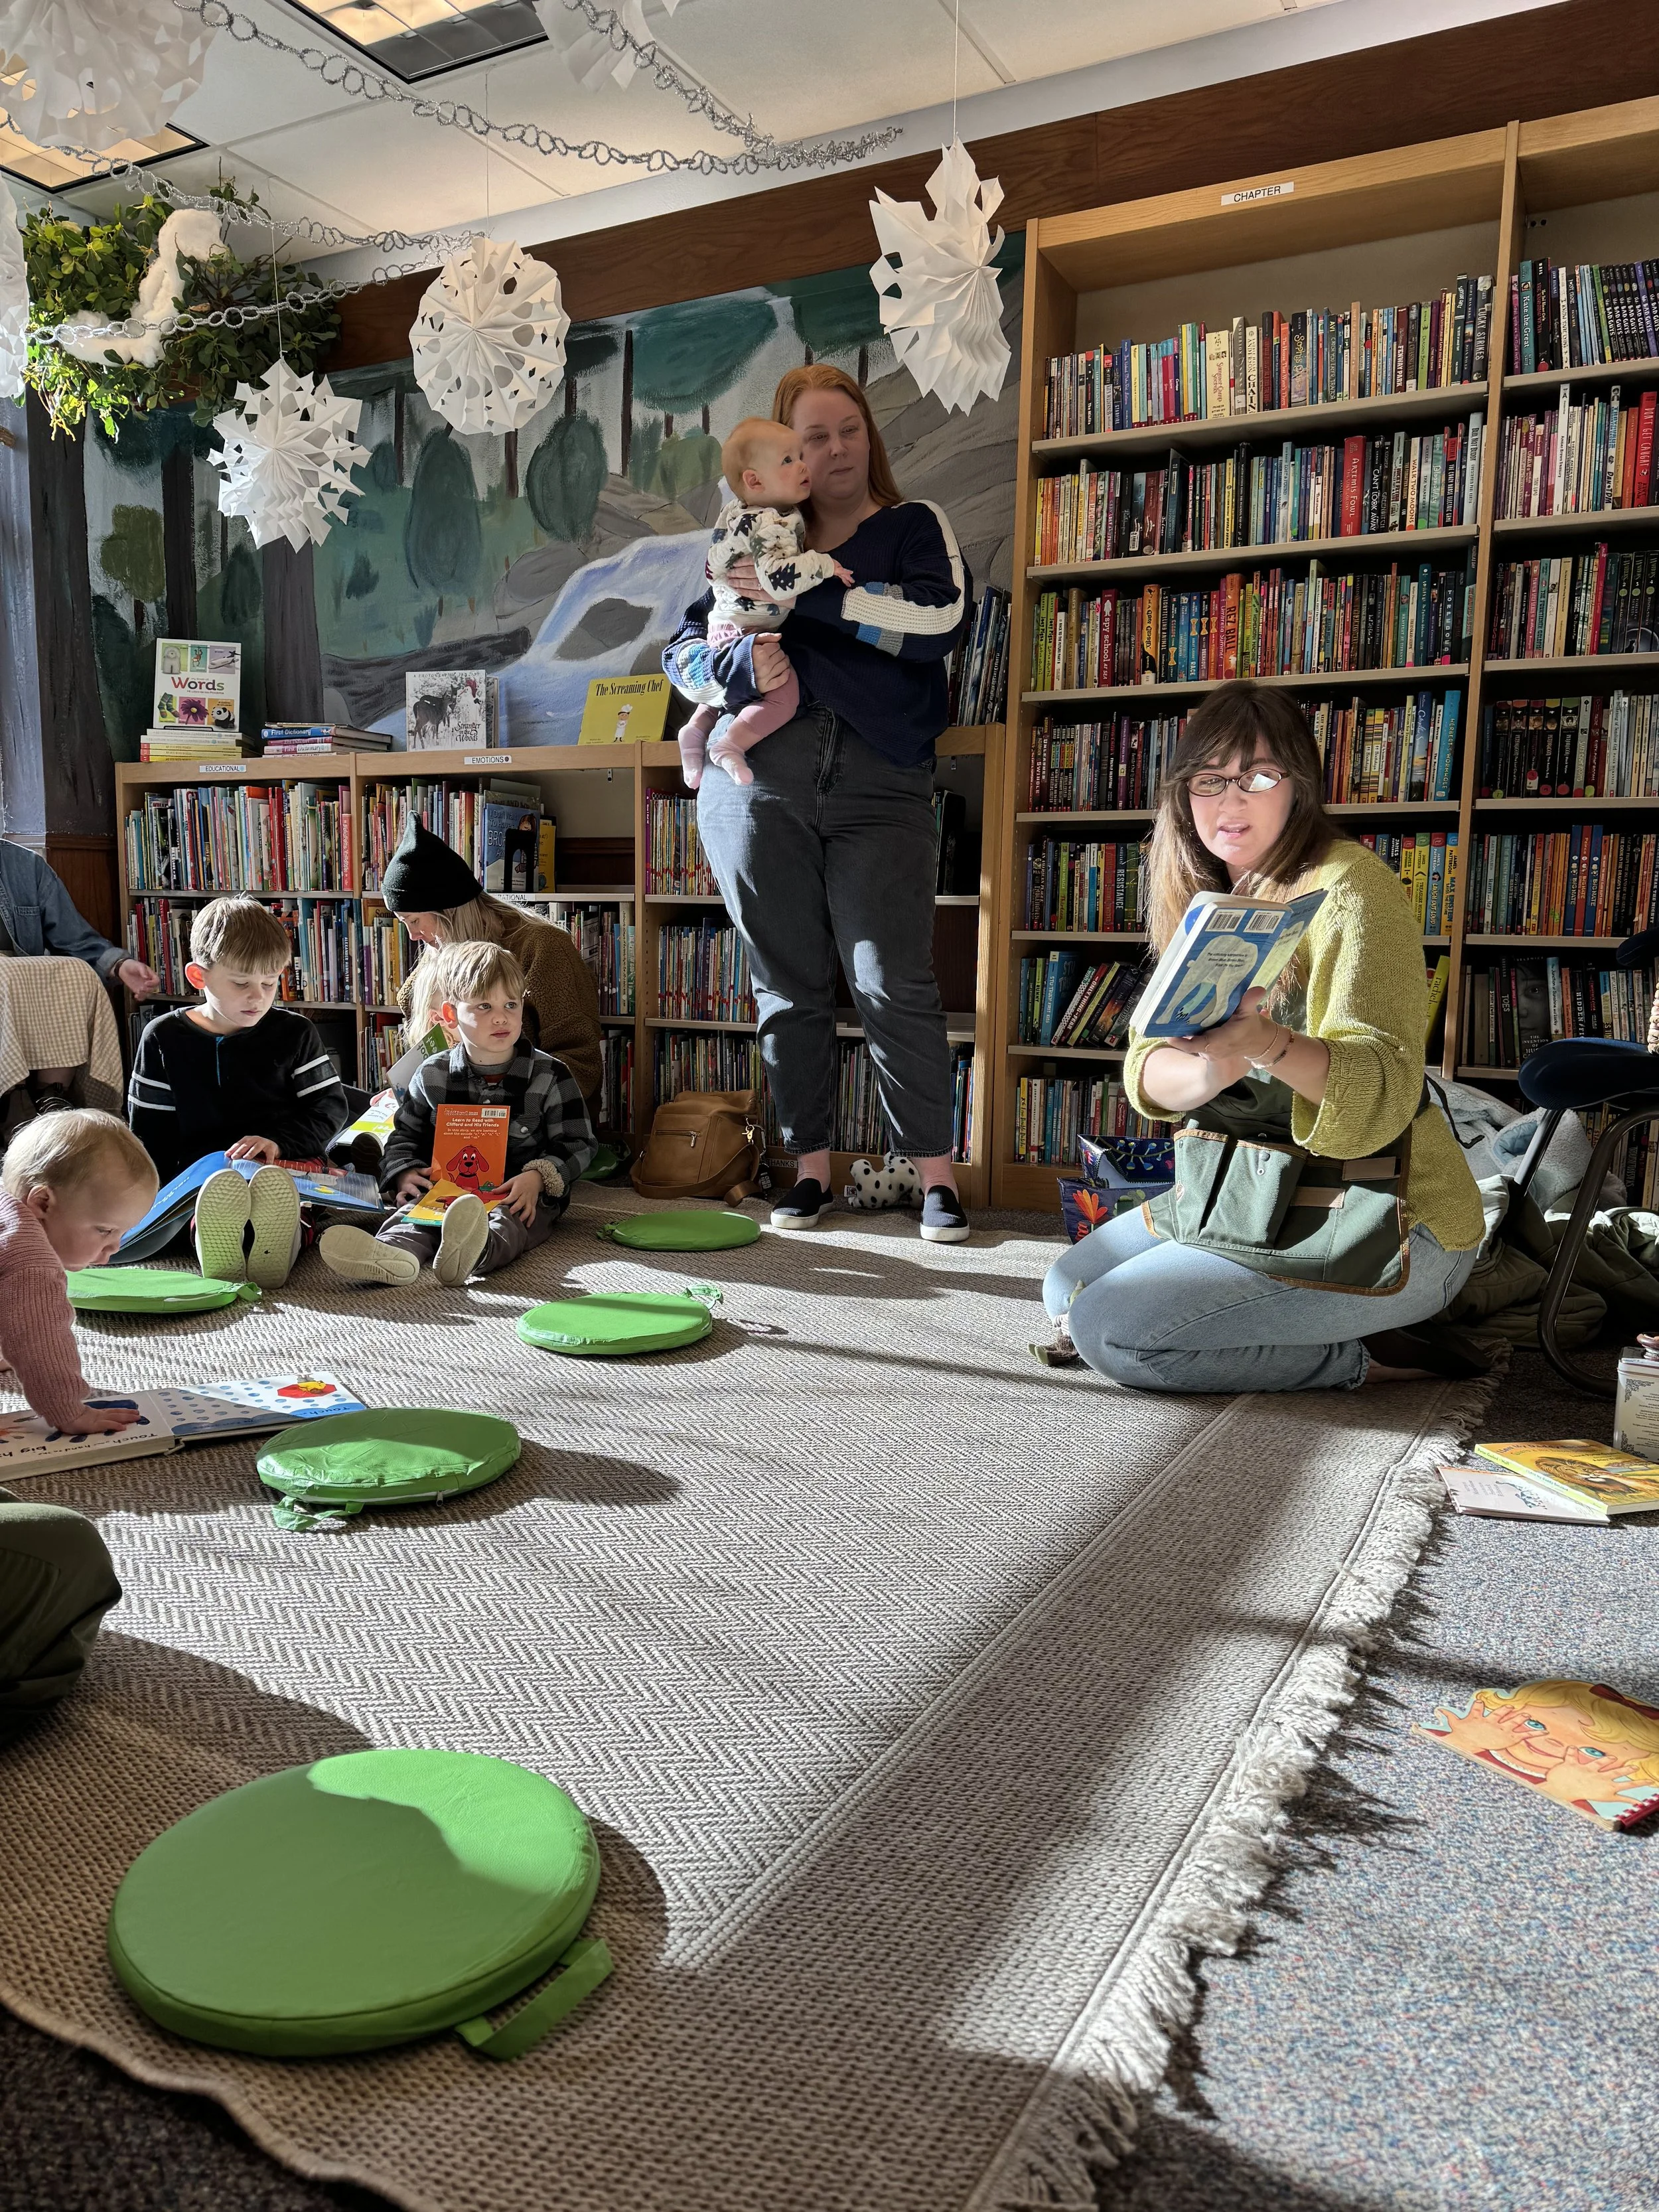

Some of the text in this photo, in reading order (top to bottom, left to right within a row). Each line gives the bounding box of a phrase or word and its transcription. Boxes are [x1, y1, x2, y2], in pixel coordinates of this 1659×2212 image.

[1234, 186, 1280, 202] CHAPTER
[1475, 307, 1486, 360] LUCKY STRIKES
[1644, 407, 1654, 425] DON'T
[1642, 428, 1652, 439] GET
[1350, 458, 1359, 492] ARTEMIS
[1225, 606, 1236, 652] REZ BALL
[1443, 590, 1453, 652] TORPEDOED
[171, 677, 224, 690] Words
[597, 680, 664, 696] The Screaming Chef
[1442, 753, 1451, 788] WORMHOLE
[113, 1433, 157, 1443] Touch
